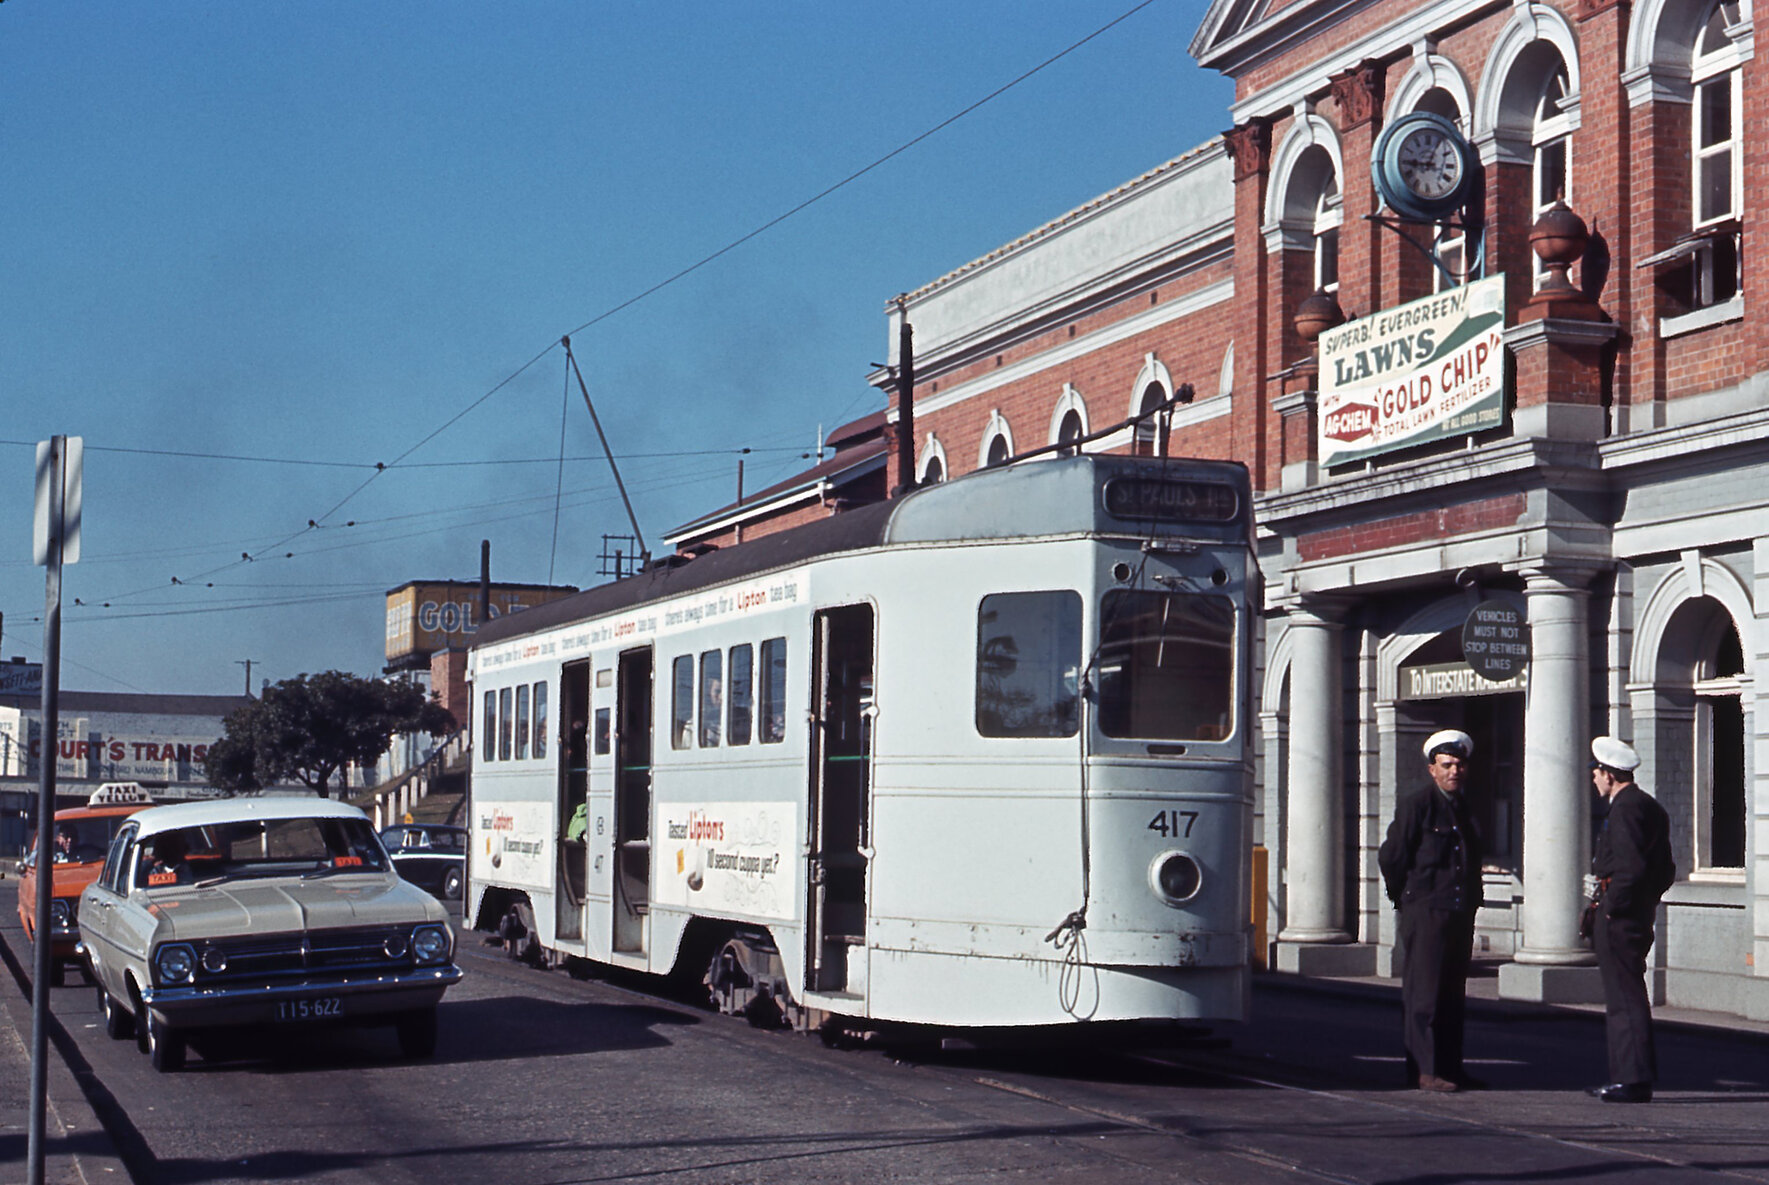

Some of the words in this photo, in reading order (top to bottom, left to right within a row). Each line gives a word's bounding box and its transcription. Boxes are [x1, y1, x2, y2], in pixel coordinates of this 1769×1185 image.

[1325, 317, 1375, 355] SUPERB!
[1335, 328, 1435, 387] LAWNS
[1384, 420, 1409, 437] TOTAL
[1414, 408, 1436, 427] LAWN
[1440, 376, 1491, 412] FERTILIZER
[737, 590, 767, 612] Lipton
[1476, 610, 1517, 623] VEHICLES
[1474, 625, 1496, 638] MUST
[1501, 627, 1519, 639] NOT
[1465, 641, 1488, 653] STOP
[1490, 643, 1527, 655] BETWEEN
[1485, 657, 1511, 670] LINES
[1423, 669, 1475, 695] INTERSTATE
[30, 736, 125, 761] CURT'S
[98, 793, 147, 803] YELLOW
[107, 785, 136, 794] TAXI
[1148, 810, 1199, 838] 417
[715, 849, 739, 870] second
[739, 856, 760, 879] cuppa
[151, 873, 173, 883] TAXI
